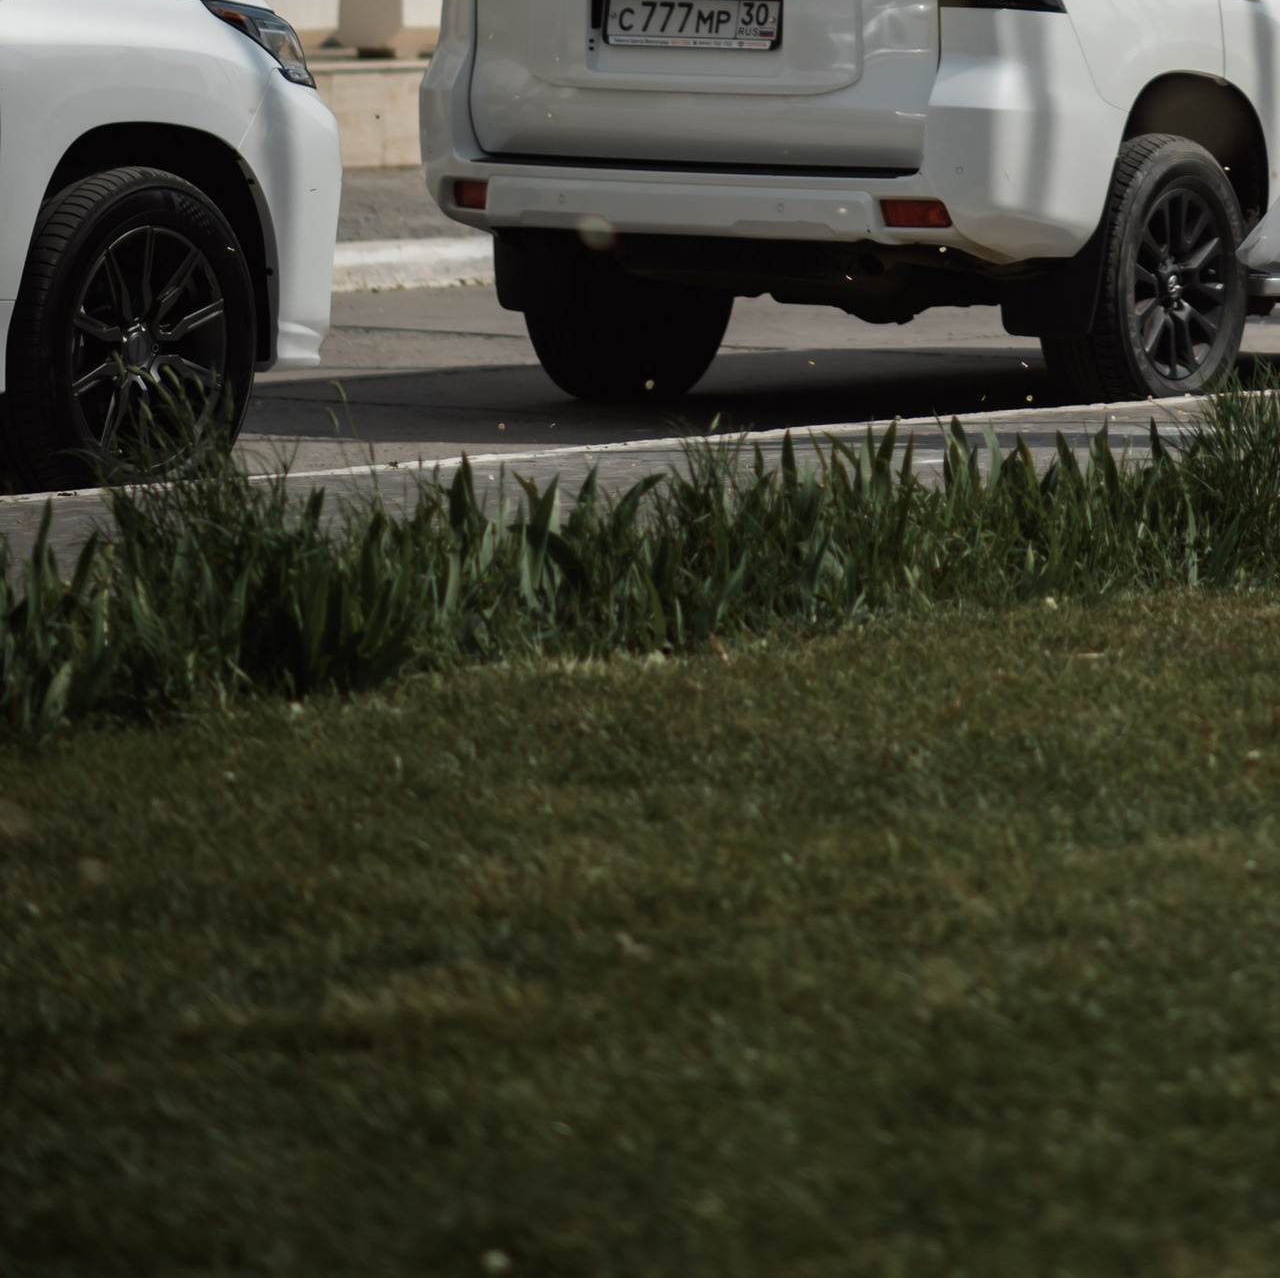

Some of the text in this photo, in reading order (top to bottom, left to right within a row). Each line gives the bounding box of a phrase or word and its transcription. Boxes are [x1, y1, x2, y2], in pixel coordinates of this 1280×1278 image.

[618, 1, 769, 34] С777МР 30
[737, 27, 759, 37] RUS
